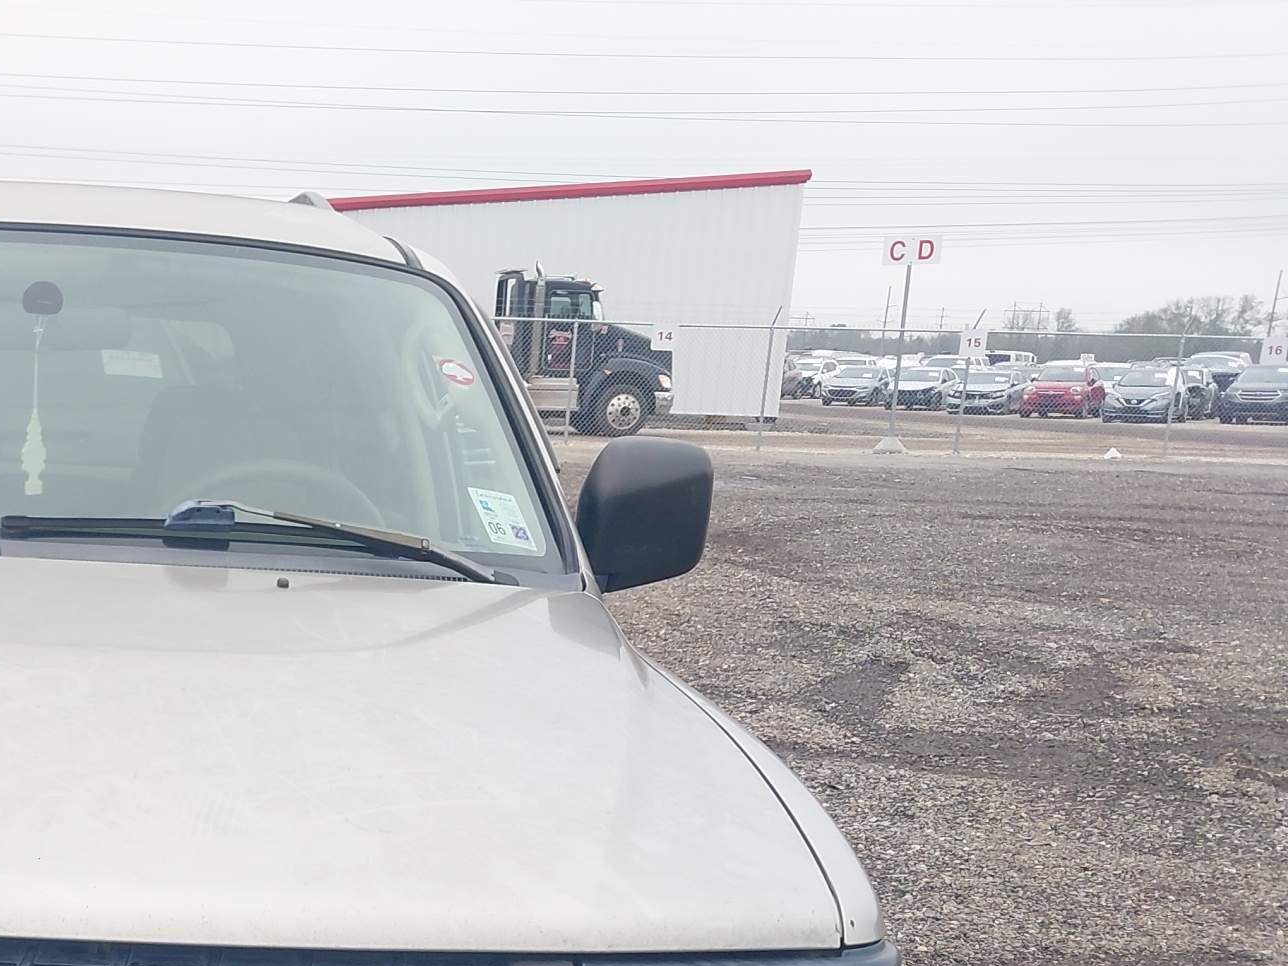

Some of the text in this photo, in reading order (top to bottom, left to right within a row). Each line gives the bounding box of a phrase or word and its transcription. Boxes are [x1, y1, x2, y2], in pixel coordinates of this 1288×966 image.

[889, 239, 934, 261] C D
[657, 331, 673, 342] 14
[967, 337, 982, 348] 15
[1268, 345, 1283, 356] 16
[487, 521, 530, 541] 06 23
